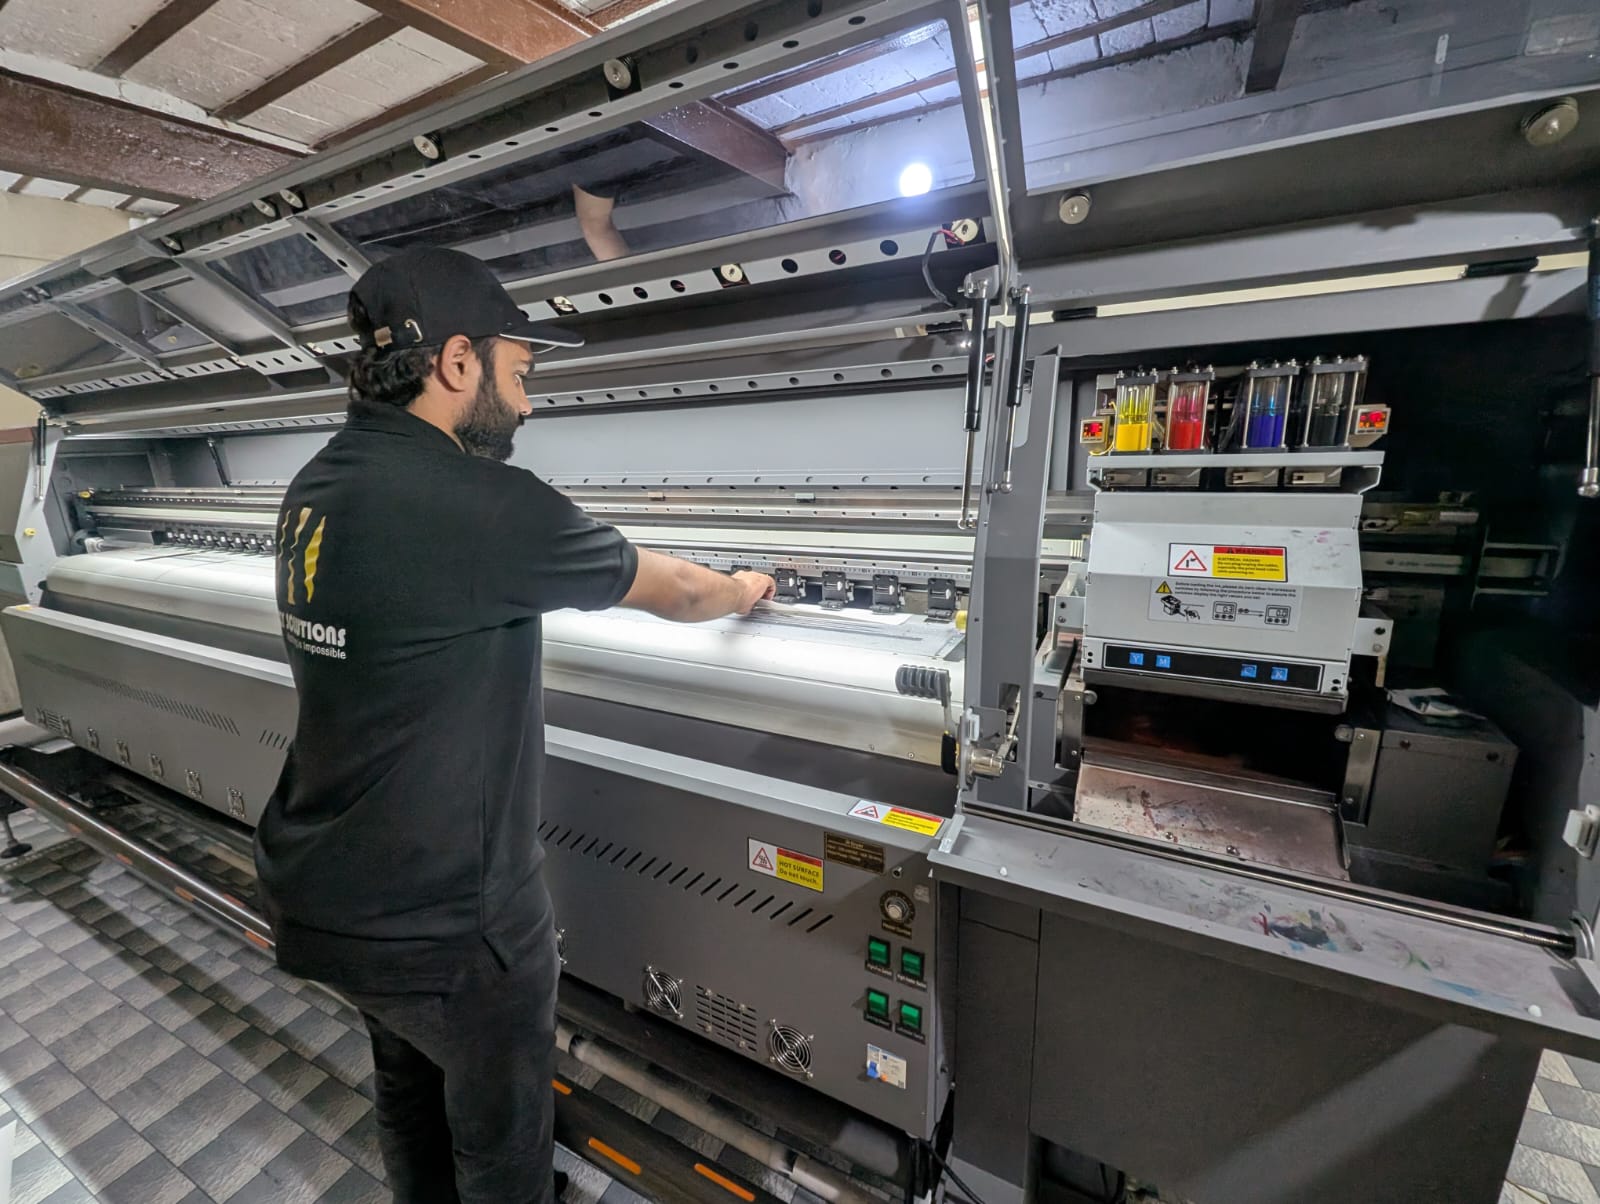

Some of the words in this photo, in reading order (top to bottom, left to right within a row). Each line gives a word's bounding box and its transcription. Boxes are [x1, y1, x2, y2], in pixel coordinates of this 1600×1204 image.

[779, 860, 792, 869] HOT
[793, 864, 819, 877] SURFACE
[780, 868, 788, 876] Do
[788, 871, 799, 879] not
